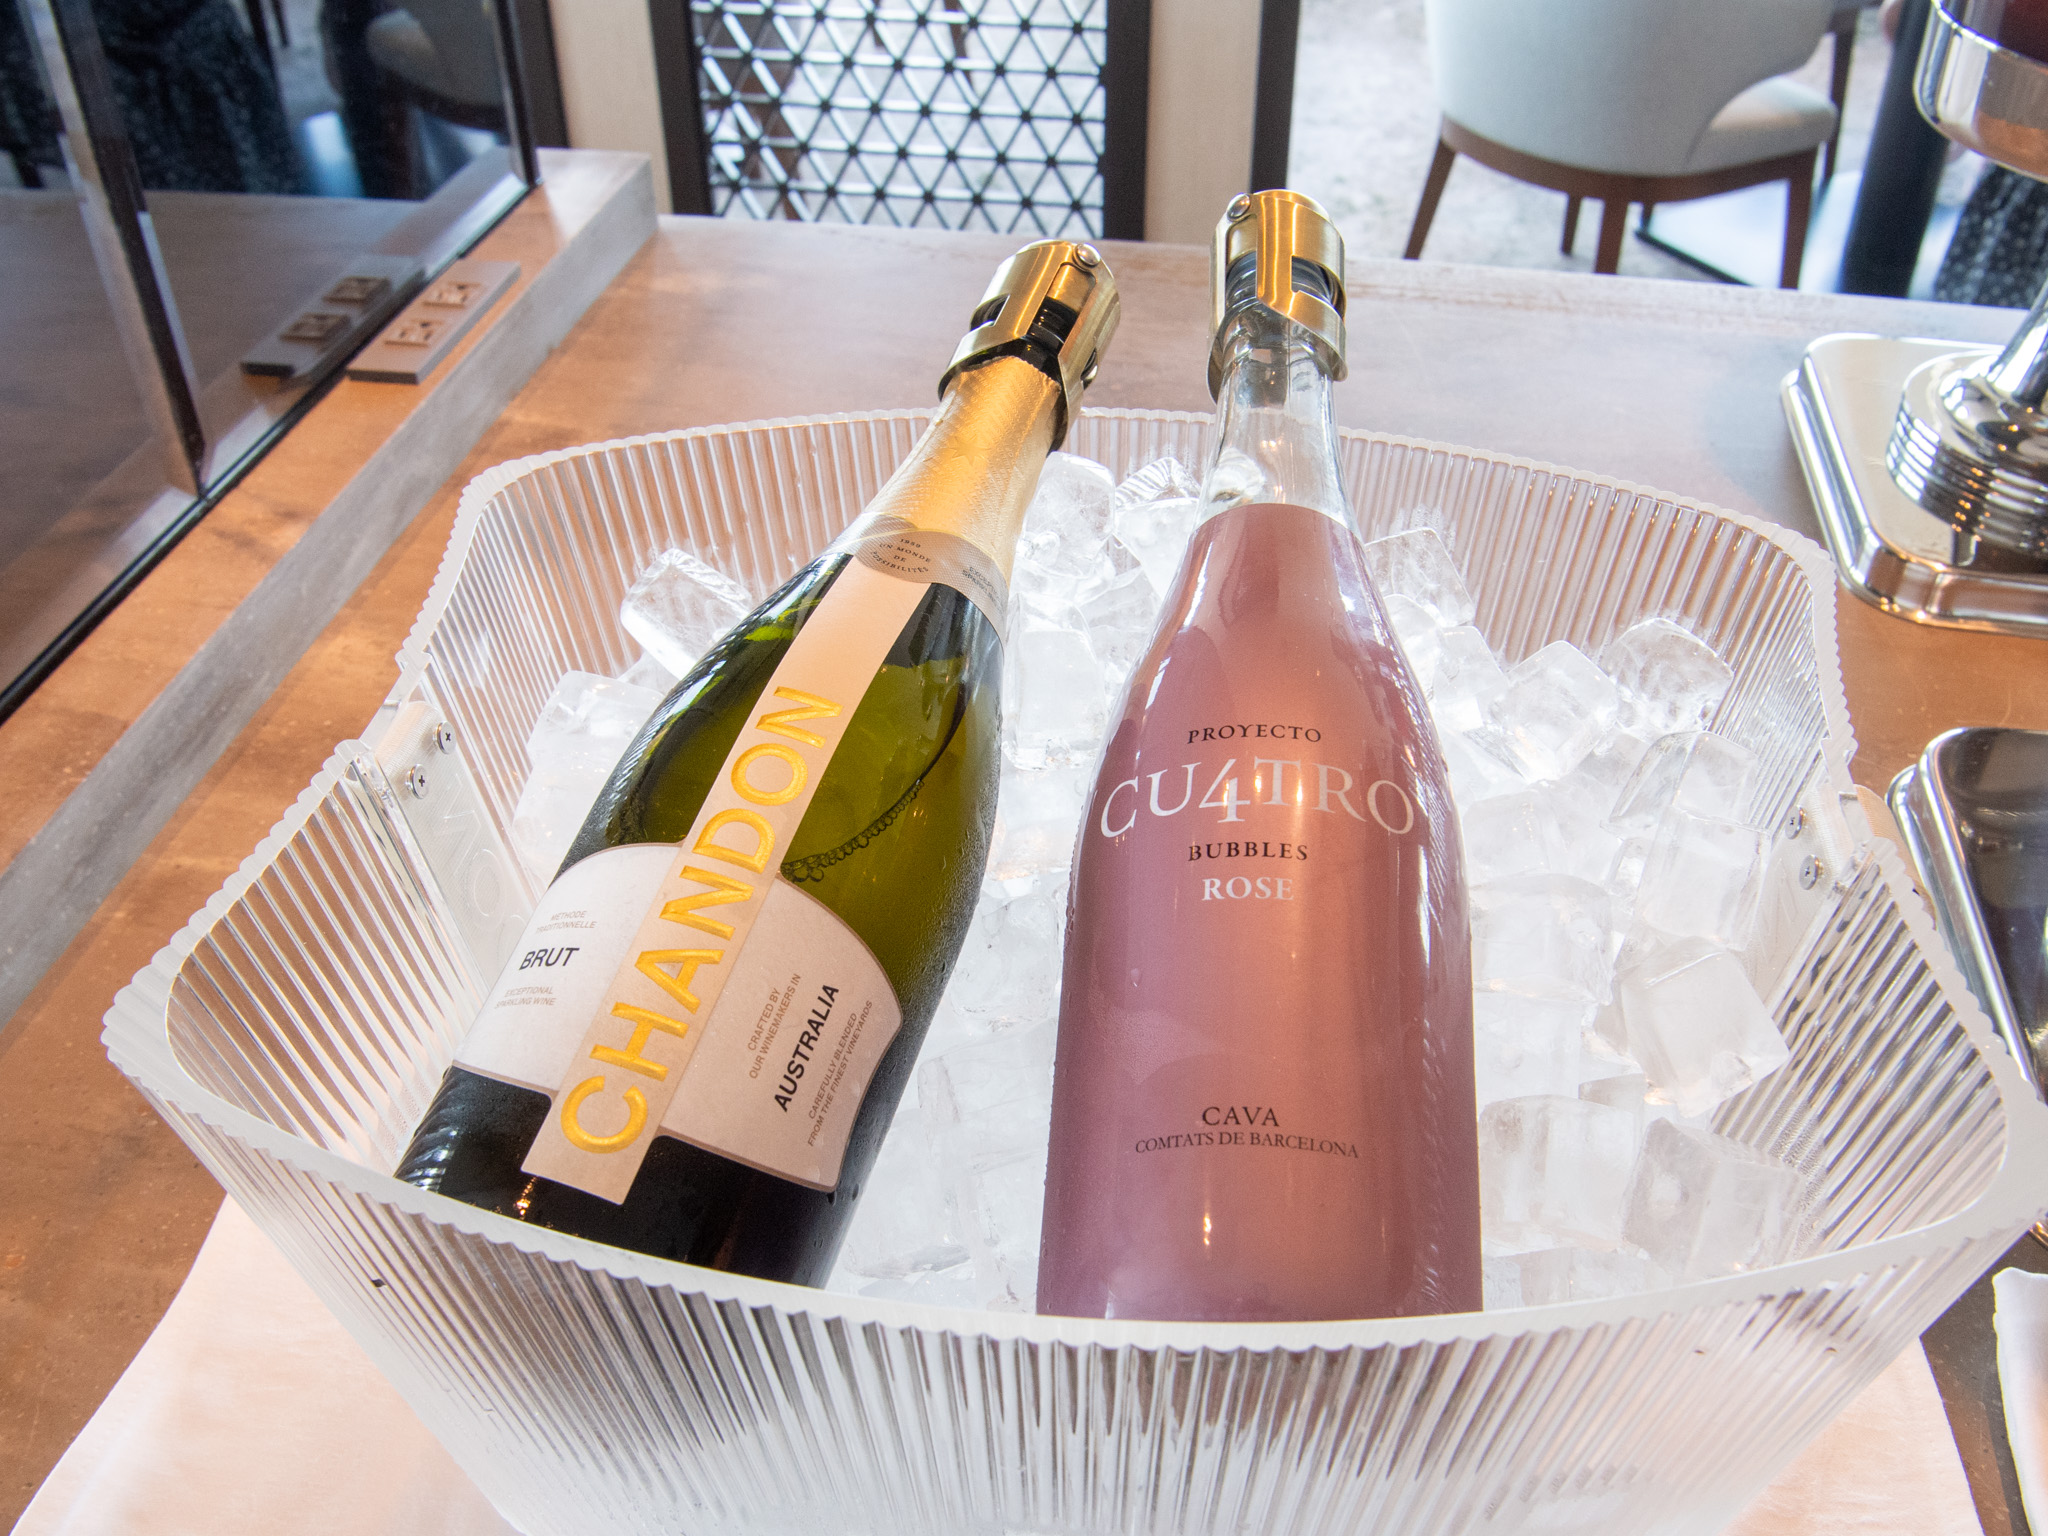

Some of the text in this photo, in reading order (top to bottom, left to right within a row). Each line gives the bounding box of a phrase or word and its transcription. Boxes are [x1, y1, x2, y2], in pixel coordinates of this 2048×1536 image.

[893, 555, 907, 563] DE
[896, 546, 932, 563] MONDE
[1187, 724, 1322, 744] PROYECTO
[1100, 755, 1415, 838] CU4TRO
[1188, 841, 1309, 862] BUBBLES
[1202, 875, 1295, 902] ROSE
[535, 920, 598, 934] TRADITIONNELLE
[560, 685, 844, 1155] CHANDON
[518, 946, 580, 971] BRUT
[494, 997, 557, 1010] SPARKLING WINE
[504, 986, 554, 998] EXCEPTIONAL
[747, 987, 782, 1051] CRAFTED BY
[749, 973, 802, 1080] OUR WINEMAKERS IN
[773, 984, 840, 1113] AUSTRALIA
[807, 1000, 873, 1147] FROM THE FINEST VINEYARDS
[808, 1012, 858, 1120] CAREFULLY BLENDED
[1202, 1105, 1281, 1128] CAVA
[1135, 1131, 1360, 1159] COMTATS DE BARCELONA
